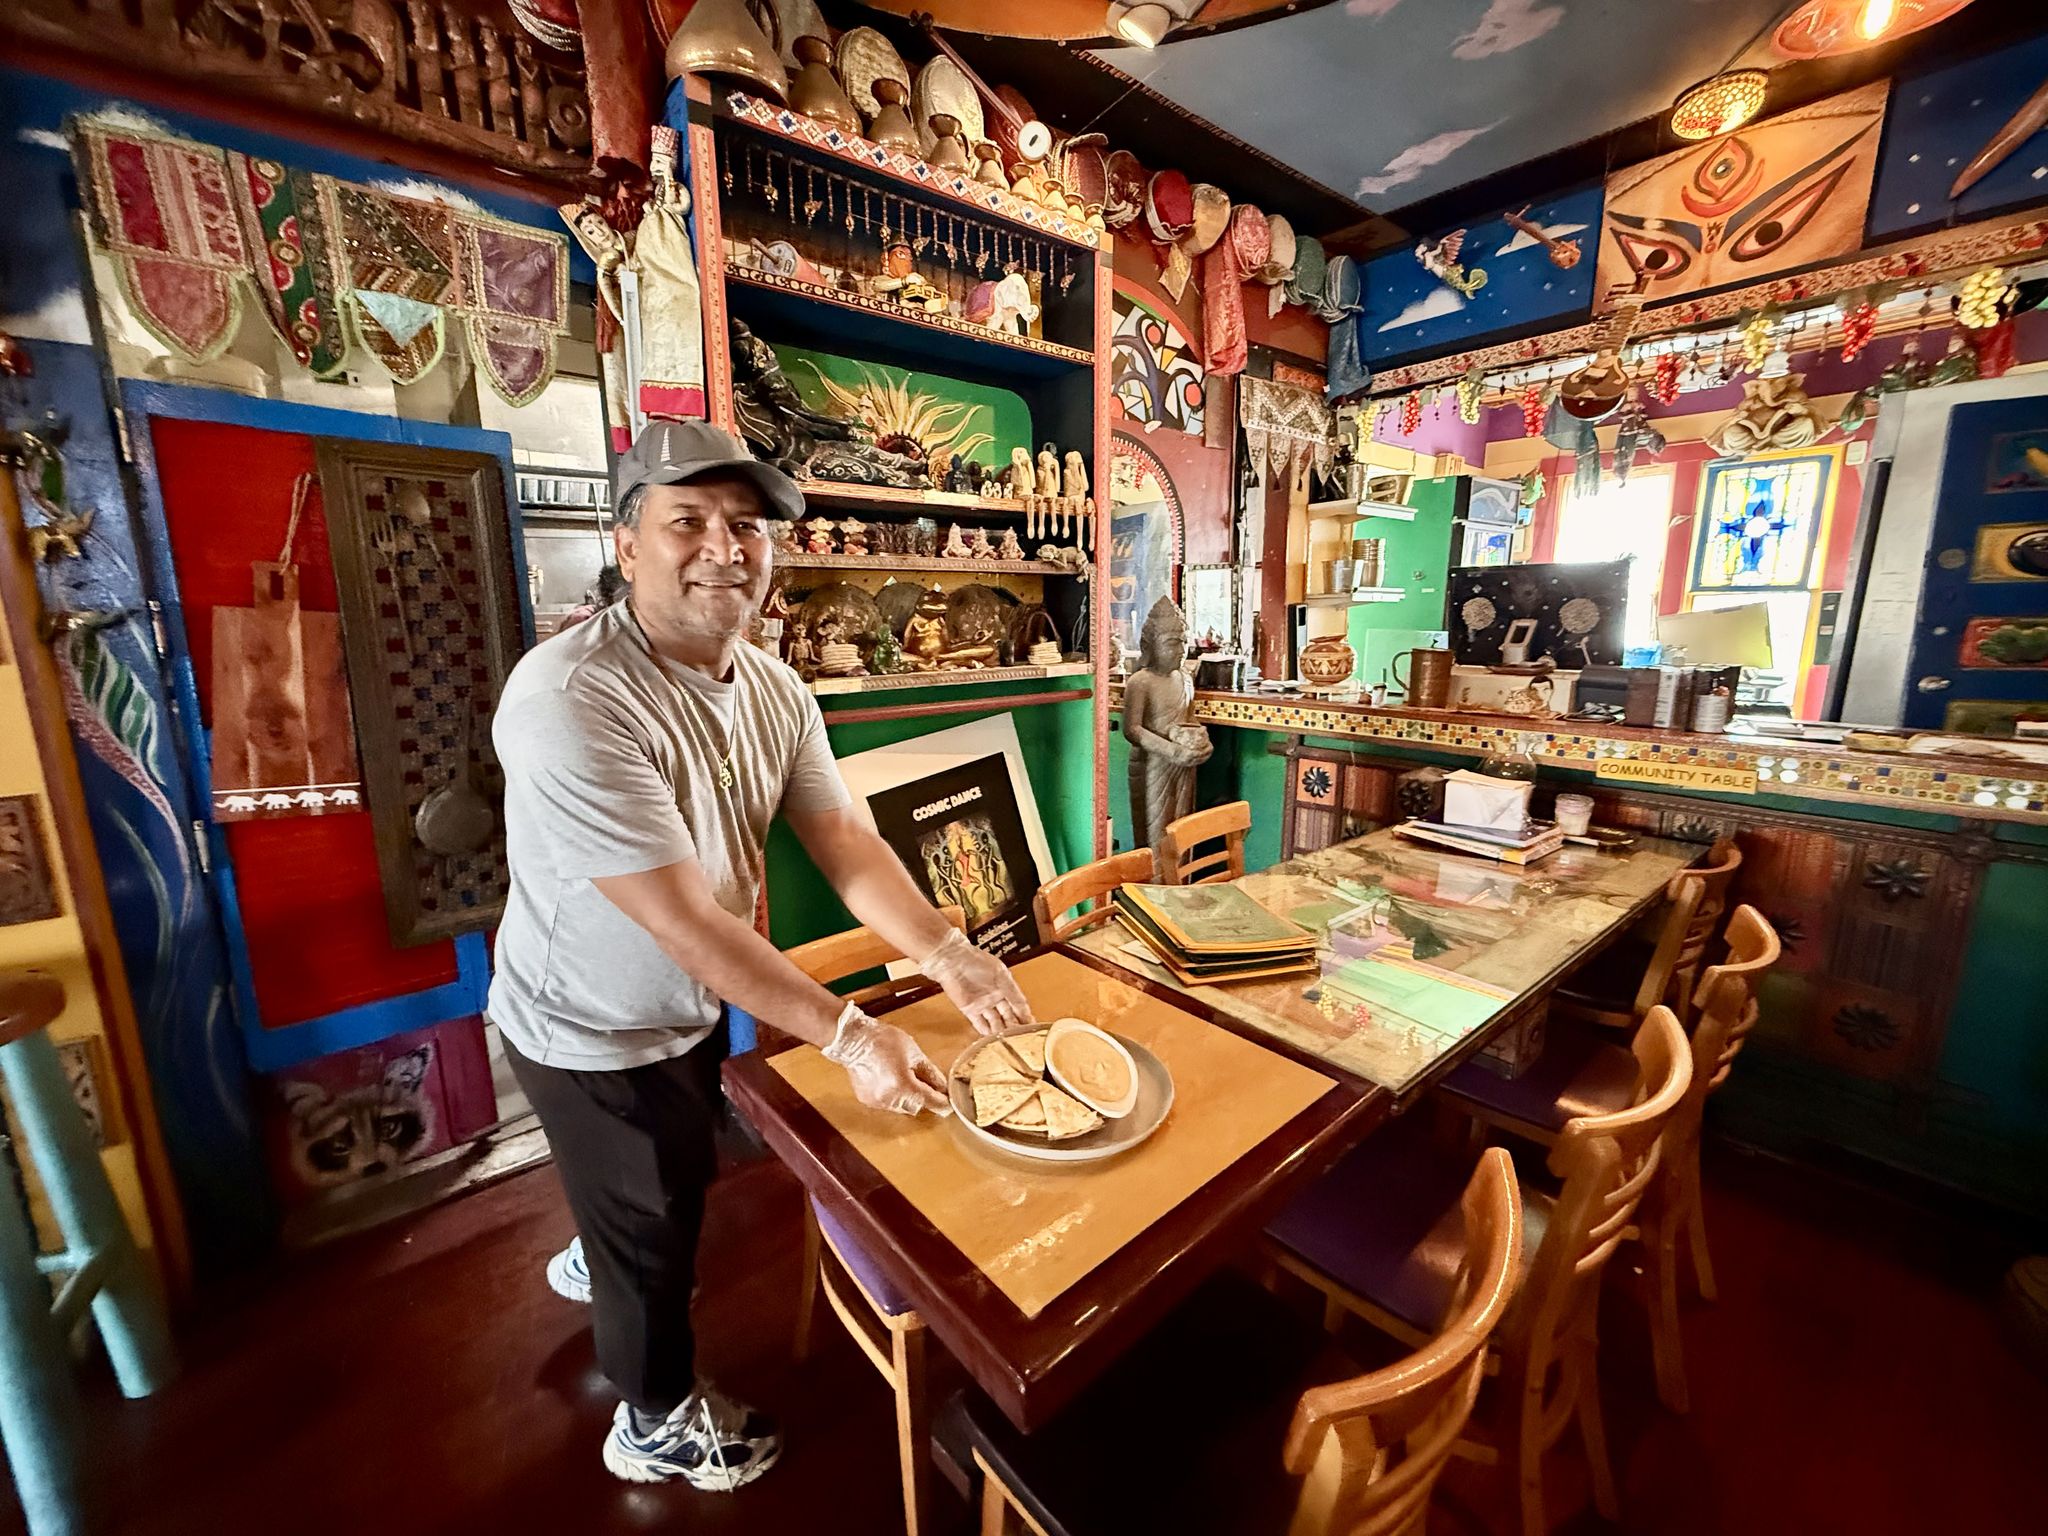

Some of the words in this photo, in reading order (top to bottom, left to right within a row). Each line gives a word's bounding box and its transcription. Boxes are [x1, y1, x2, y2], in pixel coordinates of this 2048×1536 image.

[1599, 763, 1696, 782] COMMUNITY
[1701, 772, 1752, 789] TABLE
[912, 797, 952, 822] COSMIC
[949, 786, 983, 808] DANCE
